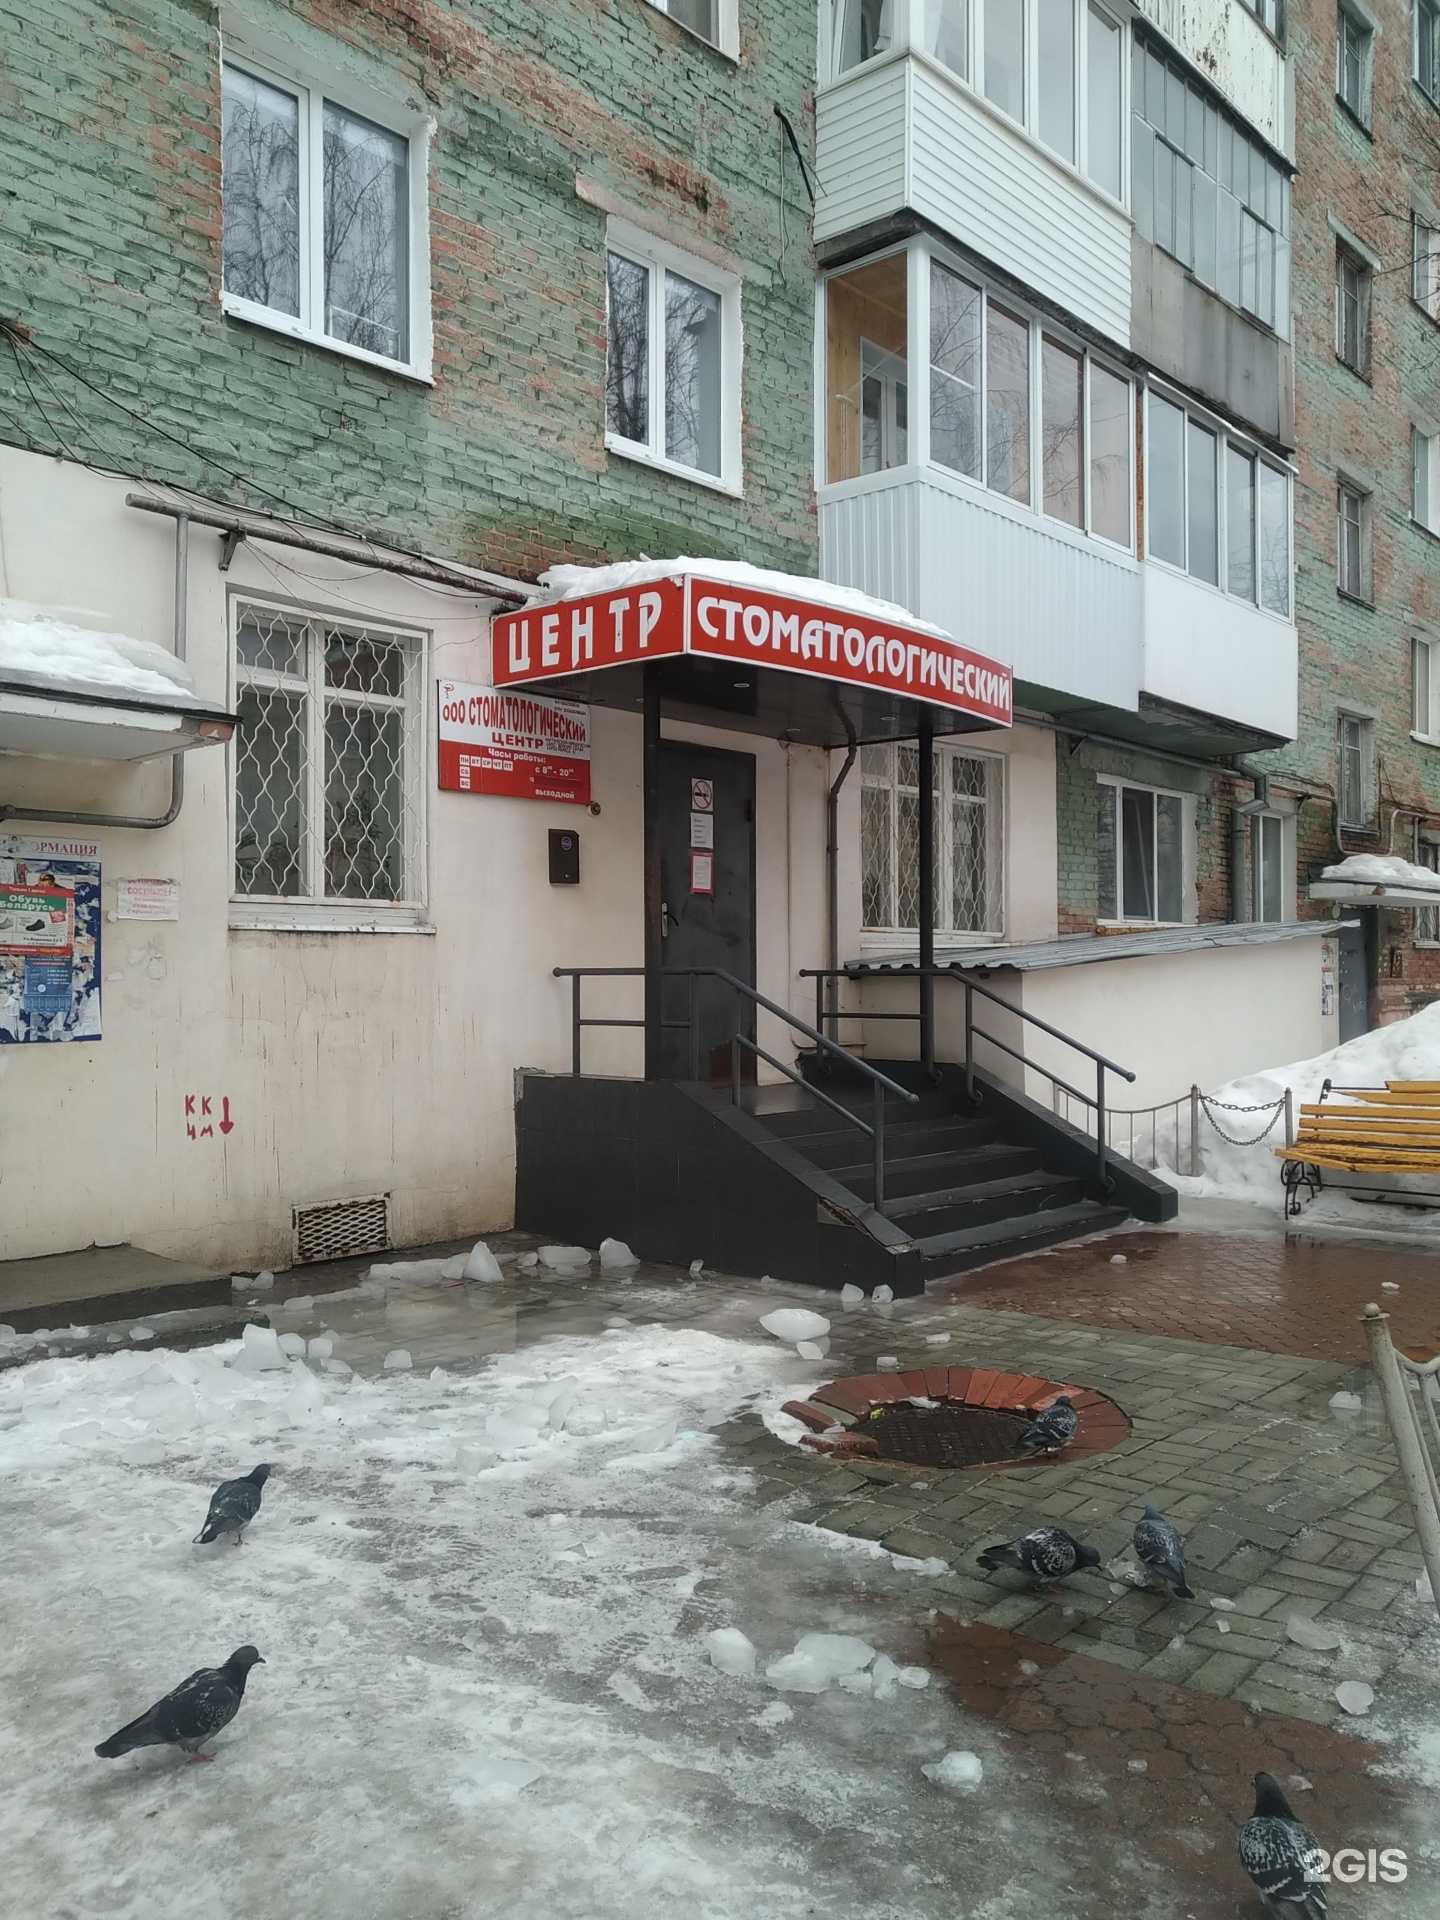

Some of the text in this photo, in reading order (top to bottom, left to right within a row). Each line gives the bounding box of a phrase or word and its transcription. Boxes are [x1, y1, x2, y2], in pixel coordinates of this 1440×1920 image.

[507, 590, 664, 674] ЦЕНТР
[696, 595, 1011, 711] СТОМАТОЛОГИЧЕСКИЙ
[442, 695, 587, 743] ООО СТОМАТОЛОГИЧЕСКИЙ
[491, 732, 544, 750] ЦЕНТР
[488, 747, 512, 759] Часы
[535, 788, 575, 800] выходной
[9, 894, 46, 904] Обувь
